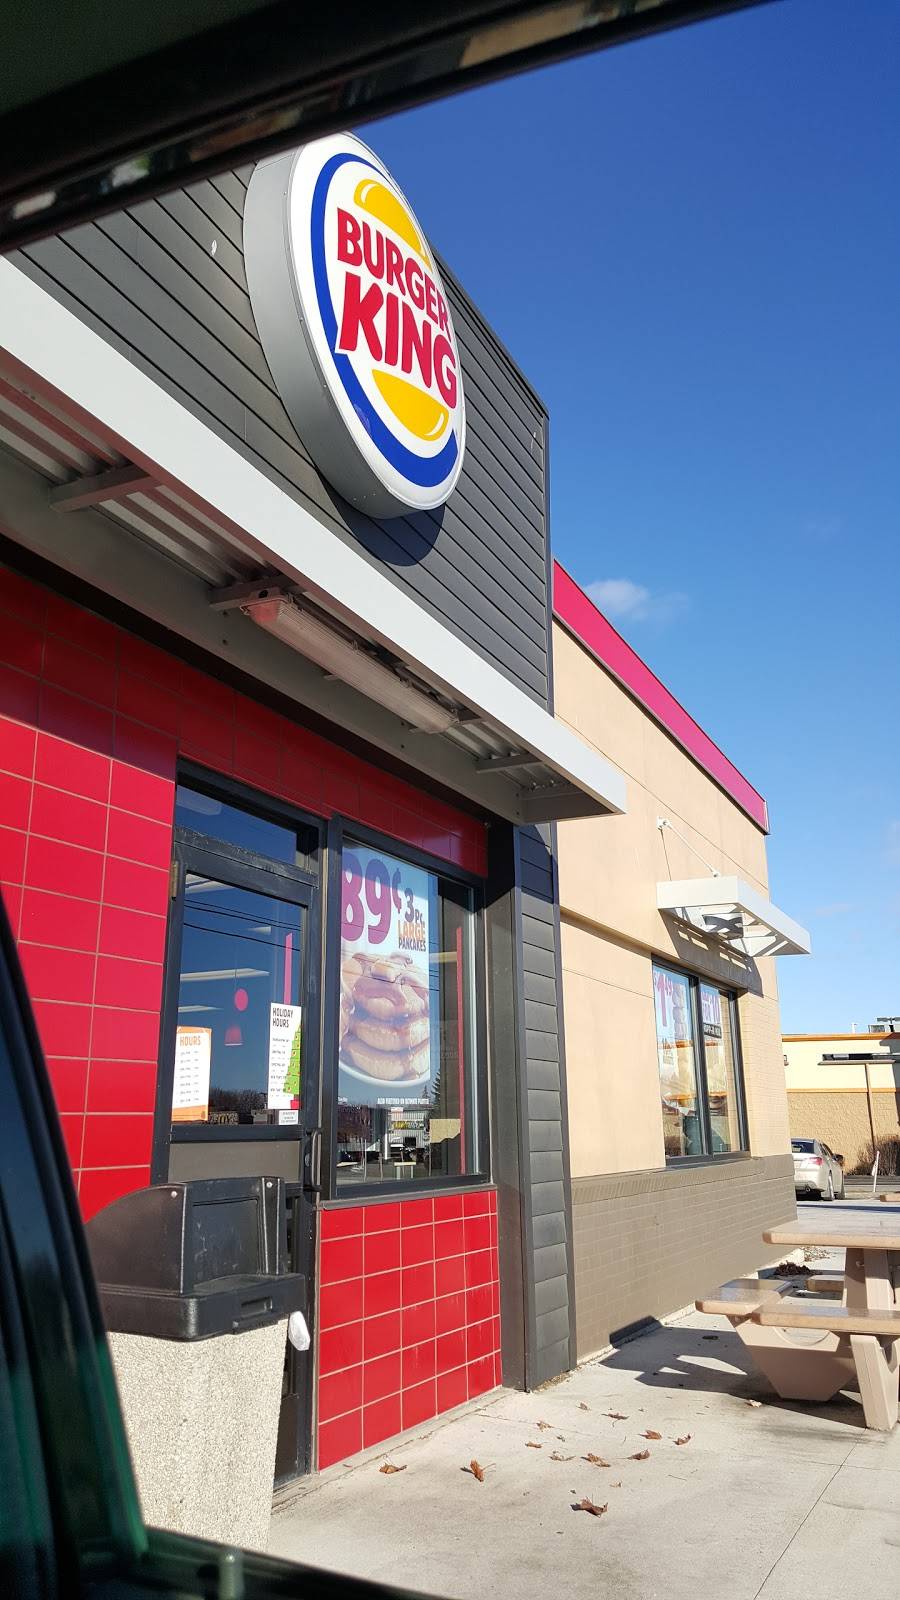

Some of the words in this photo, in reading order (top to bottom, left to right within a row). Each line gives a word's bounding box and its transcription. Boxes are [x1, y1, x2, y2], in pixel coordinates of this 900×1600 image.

[337, 207, 452, 342] BURGER
[338, 271, 457, 409] KING
[404, 887, 414, 922] 3
[398, 919, 426, 940] LARGE
[398, 937, 426, 952] PANCAKES
[272, 1007, 293, 1018] HOLIDAY
[272, 1018, 290, 1028] HOURS
[179, 1036, 201, 1047] HOURS
